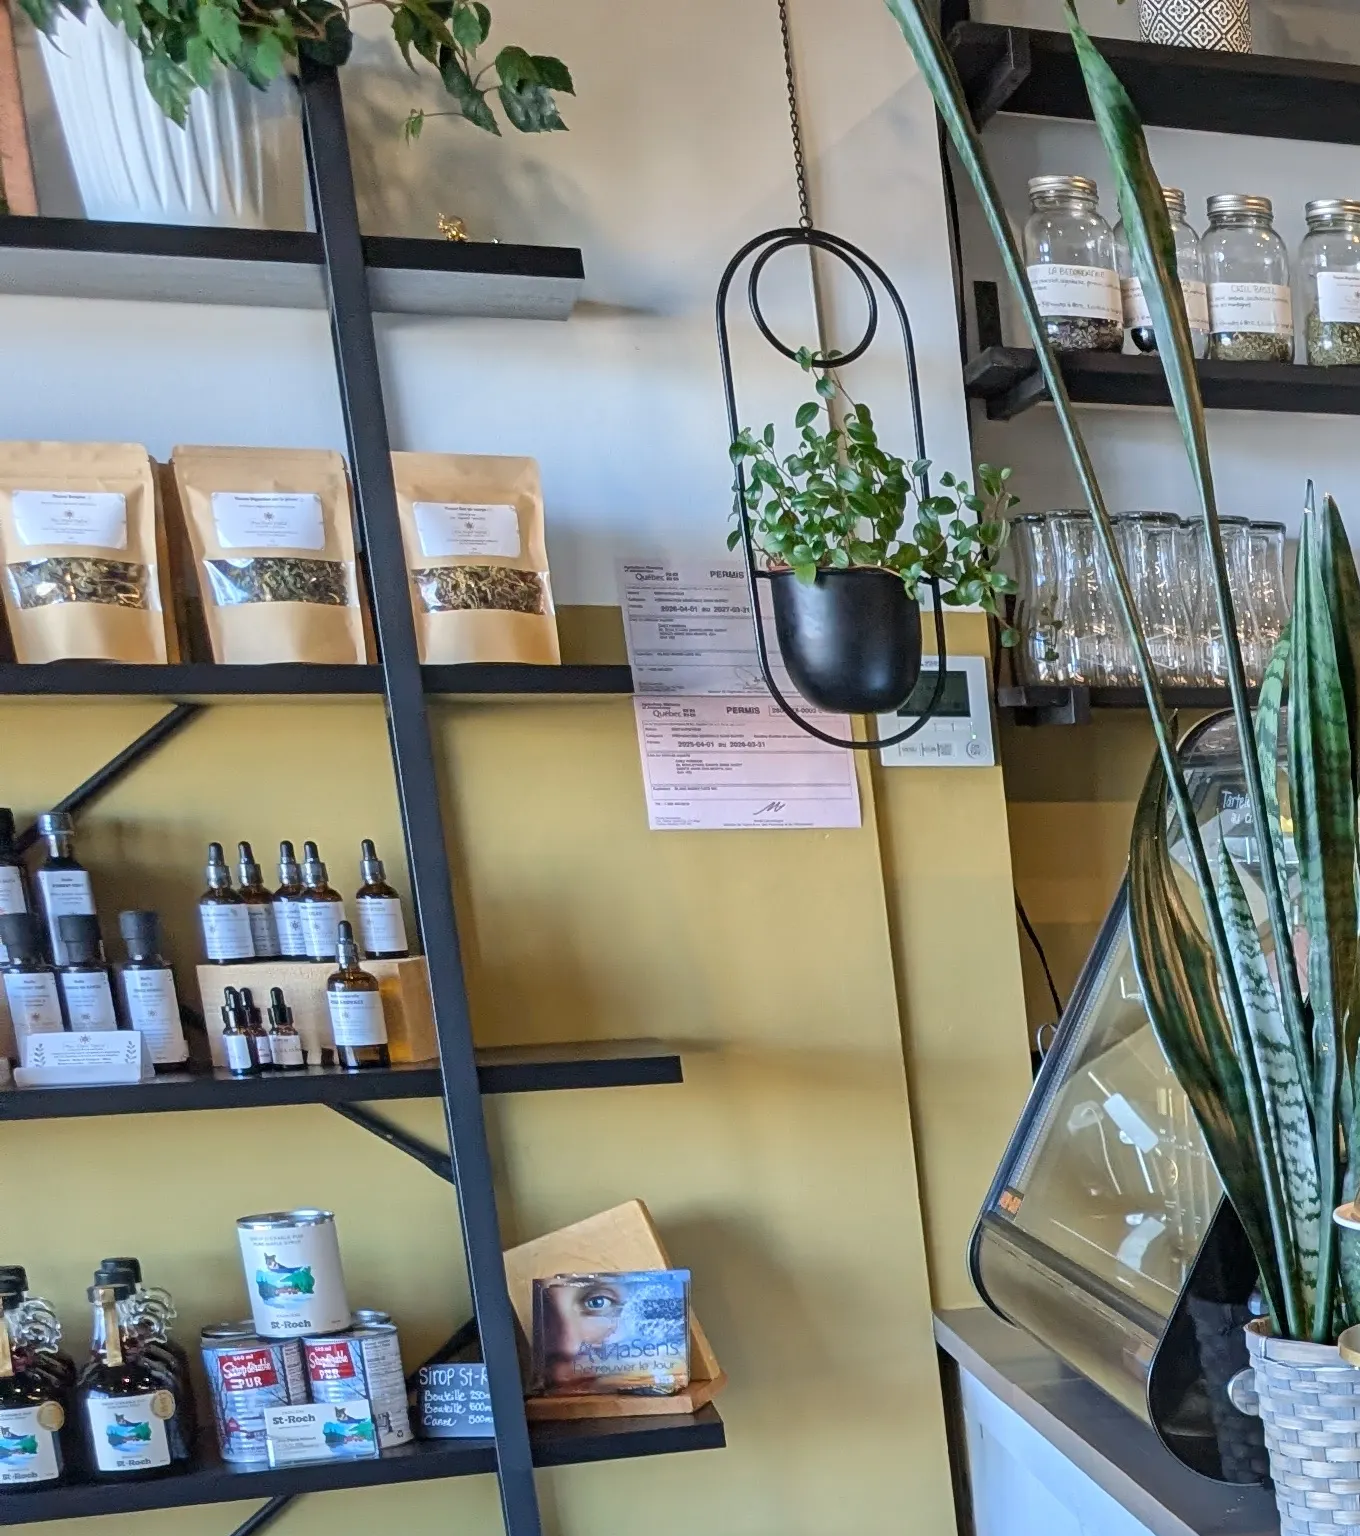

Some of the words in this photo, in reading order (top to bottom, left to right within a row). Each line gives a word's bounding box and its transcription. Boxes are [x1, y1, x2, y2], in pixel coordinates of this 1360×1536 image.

[709, 570, 745, 580] PERMIS
[652, 708, 682, 719] Québec
[726, 706, 761, 715] PERMIS
[270, 1319, 312, 1330] St-Roch
[239, 1376, 263, 1389] PUR
[419, 1367, 455, 1386] Sirop
[424, 1389, 467, 1402] Bouteille
[424, 1402, 467, 1415] Bouteille
[272, 1413, 316, 1425] St-Roch
